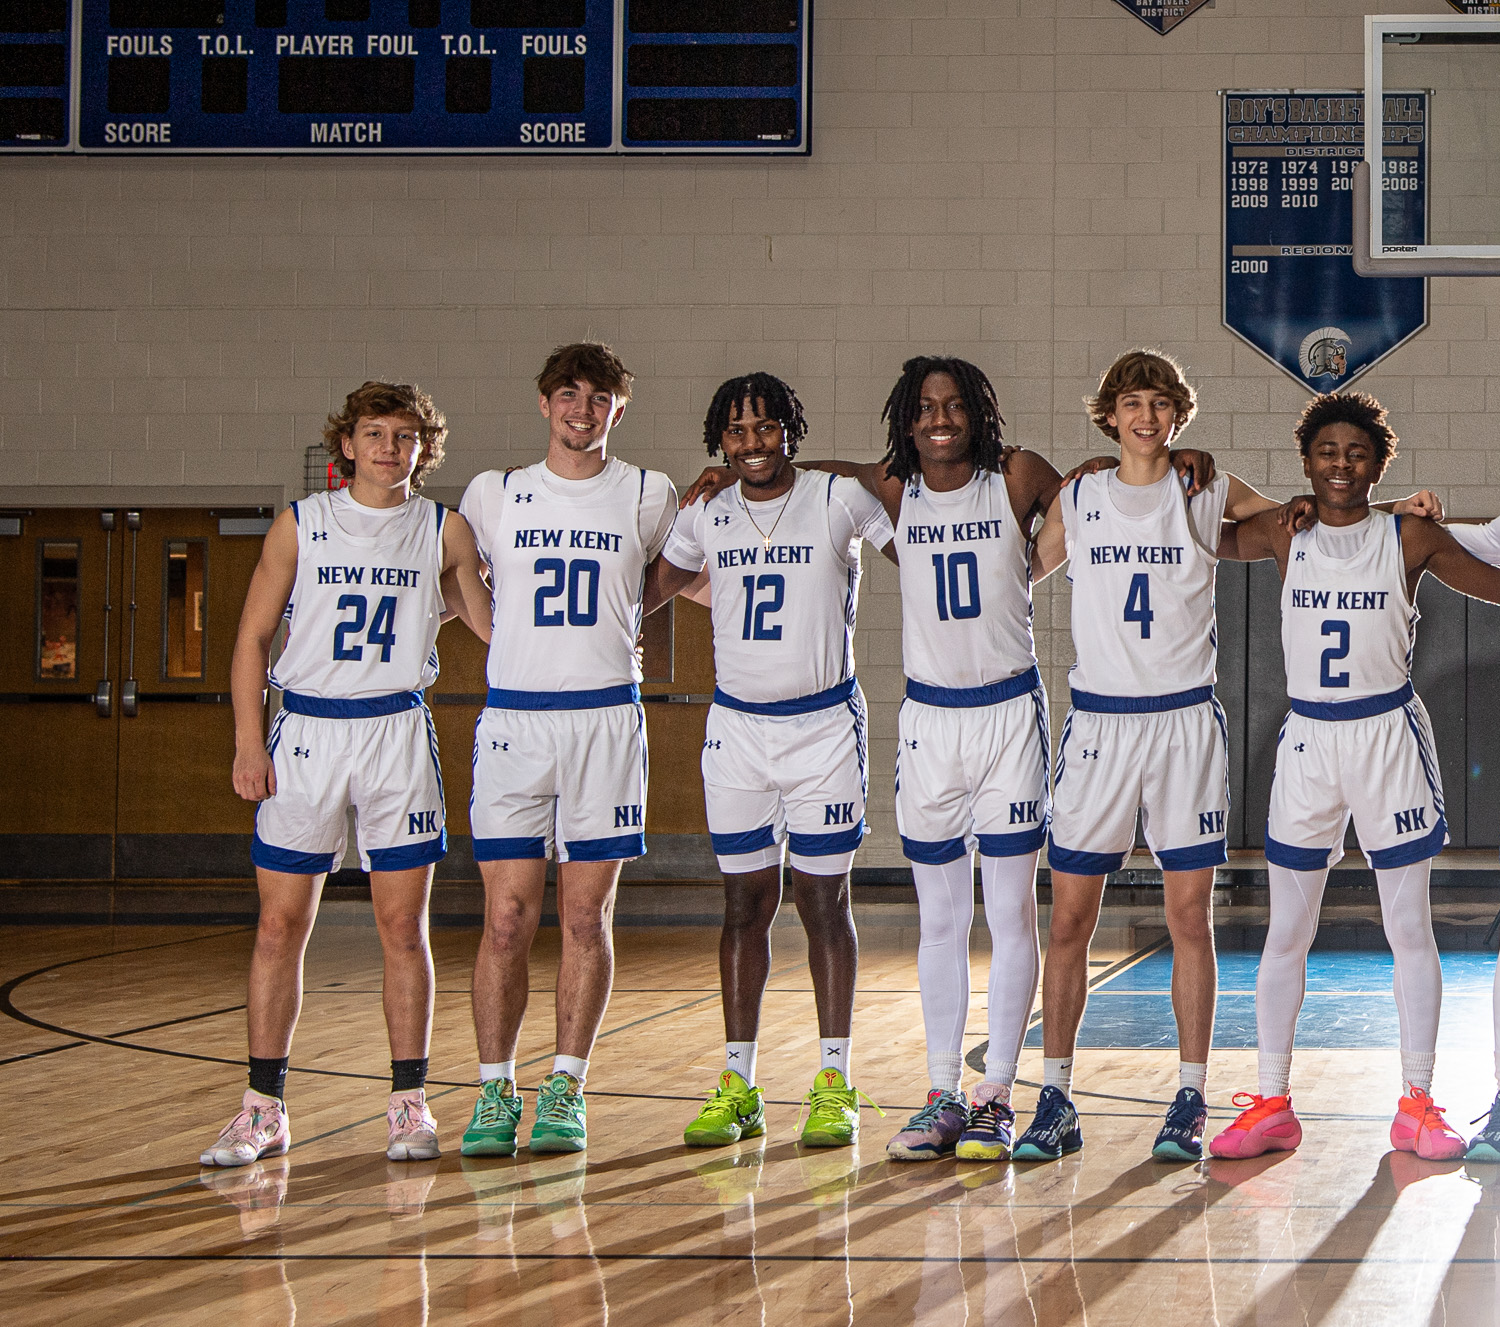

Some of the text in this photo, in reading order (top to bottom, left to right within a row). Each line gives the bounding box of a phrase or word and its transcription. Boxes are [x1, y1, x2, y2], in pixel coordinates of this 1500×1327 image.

[1141, 8, 1185, 17] DISTRICT
[107, 35, 173, 56] FOULS
[198, 35, 254, 56] T.O.L.
[276, 35, 419, 56] PLAYER FOUL
[441, 35, 497, 55] T.O.L.
[522, 35, 587, 55] FOULS
[1228, 97, 1424, 123] BOY'S BASKETALL
[104, 122, 171, 143] SCORE
[310, 122, 382, 143] MATCH
[520, 122, 586, 143] SCORE
[1228, 125, 1424, 143] CHAMPIONSIPS
[1231, 160, 1418, 174] 1972 1974 198 1982
[1231, 178, 1268, 191] 1998
[1281, 178, 1318, 191] 1999
[1381, 177, 1418, 190] 2008
[1231, 194, 1318, 208] 2009 2010
[1280, 245, 1353, 256] REGION
[1231, 260, 1268, 273] 2000
[513, 529, 623, 553] NEW KENT
[907, 519, 1002, 545] NEW KENT
[717, 545, 814, 569] NEW KENT
[1090, 545, 1184, 565] NEW KENT
[317, 566, 421, 588] NEW KENT
[931, 551, 982, 622] 10
[533, 557, 601, 628] 20
[1292, 588, 1389, 610] NEW KENT
[741, 573, 786, 641] 12
[1123, 573, 1154, 640] 4
[332, 593, 398, 663] 24
[1319, 619, 1351, 688] 2
[407, 810, 439, 836] NK
[613, 804, 642, 829] NK
[823, 801, 855, 826] NK
[1008, 799, 1040, 825] NK
[1198, 809, 1225, 836] NK
[1393, 806, 1429, 836] NK
